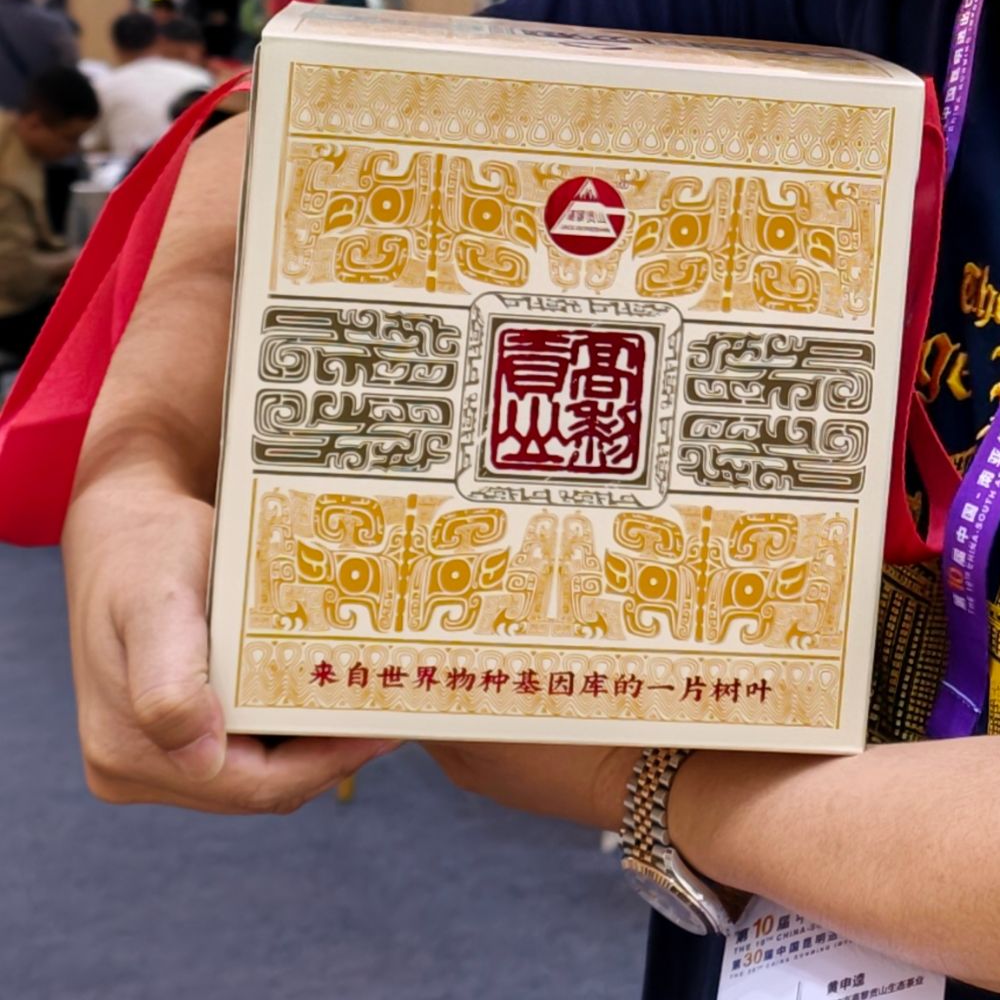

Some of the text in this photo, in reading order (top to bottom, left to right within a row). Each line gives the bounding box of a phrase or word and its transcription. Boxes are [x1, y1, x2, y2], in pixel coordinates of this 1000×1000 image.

[308, 659, 774, 704] 来自世界物种基因库的一片树叶
